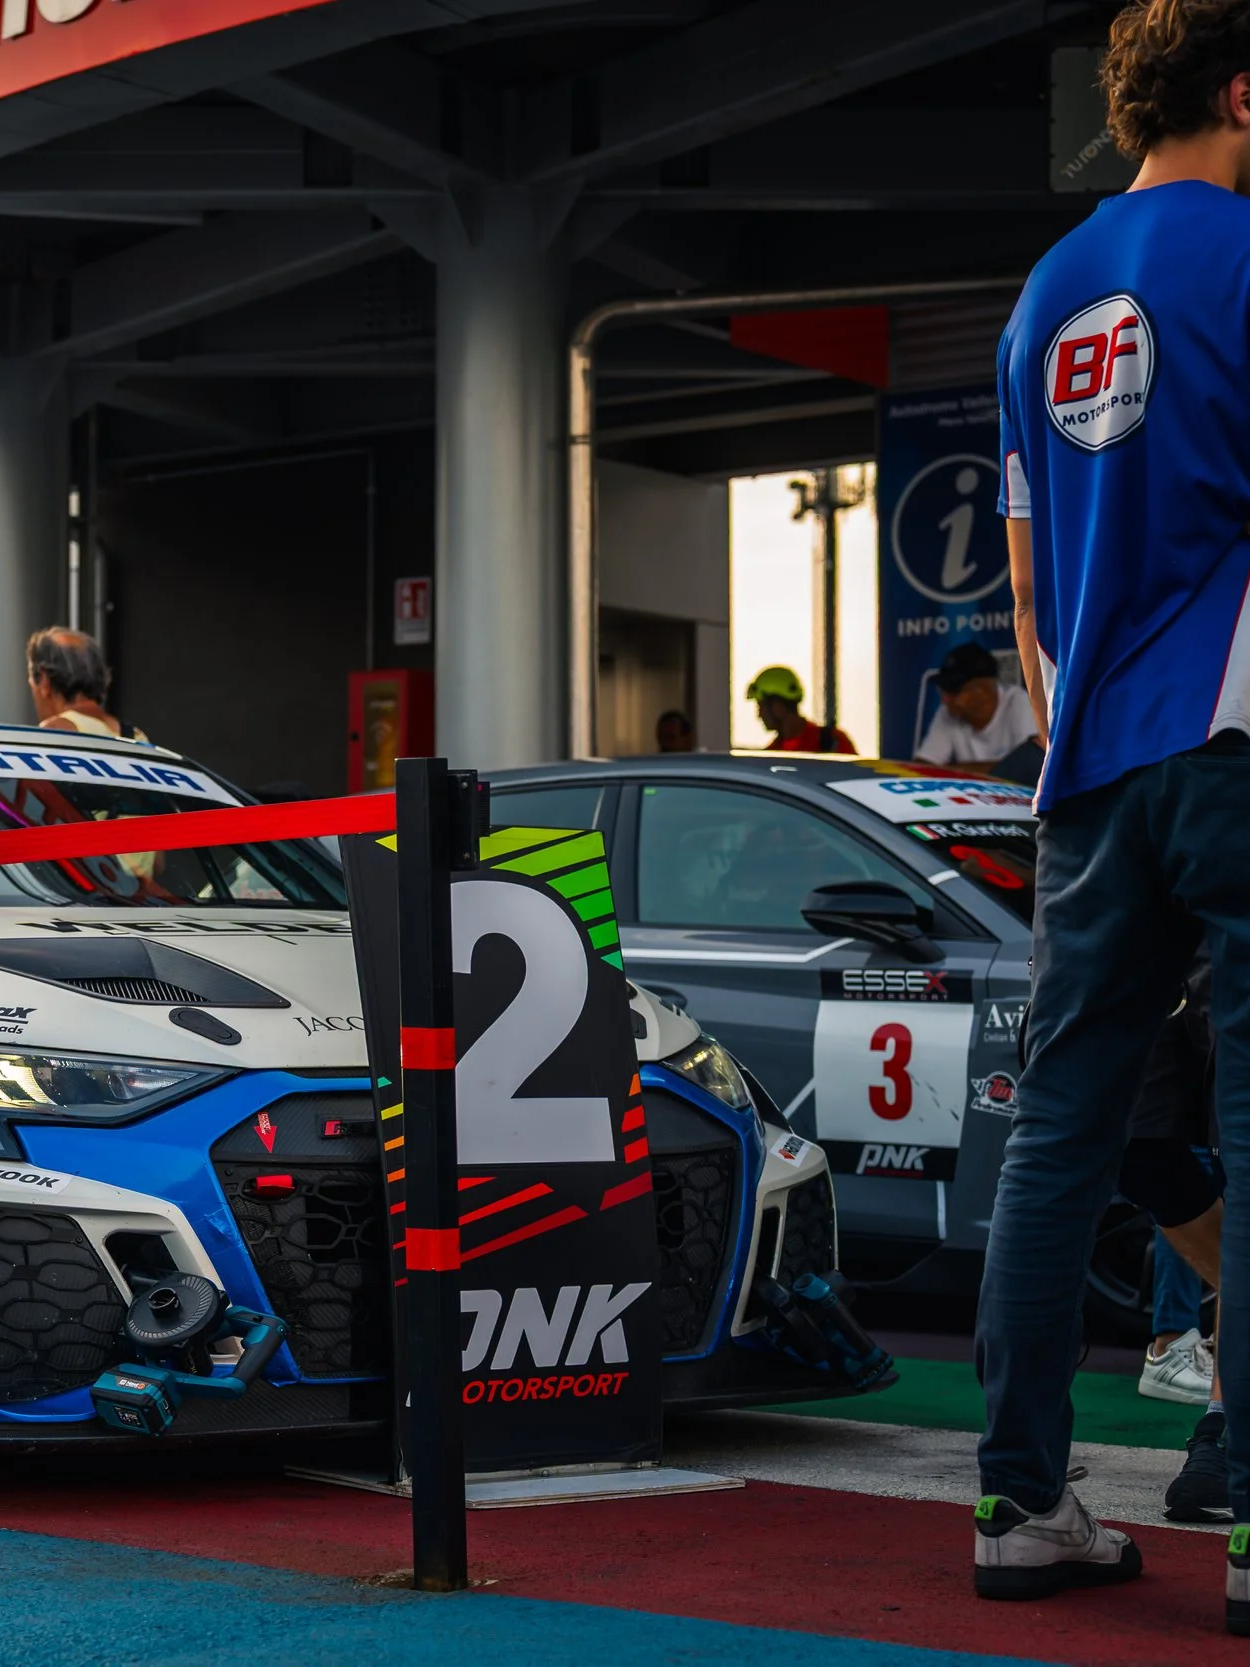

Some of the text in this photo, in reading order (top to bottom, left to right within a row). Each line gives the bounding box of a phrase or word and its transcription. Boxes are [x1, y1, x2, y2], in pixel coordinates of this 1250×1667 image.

[1052, 315, 1139, 407] BF
[1062, 392, 1145, 427] MOTORSPOR
[897, 610, 1014, 638] INFO POIN
[950, 844, 1025, 889] 3
[17, 920, 352, 935] WELDE
[842, 969, 947, 992] ESSEX
[450, 880, 616, 1165] 2
[985, 1003, 1025, 1028] Avi
[869, 1022, 913, 1121] 3
[856, 1144, 931, 1174] PNK
[461, 1372, 630, 1405] OTORSPORT
